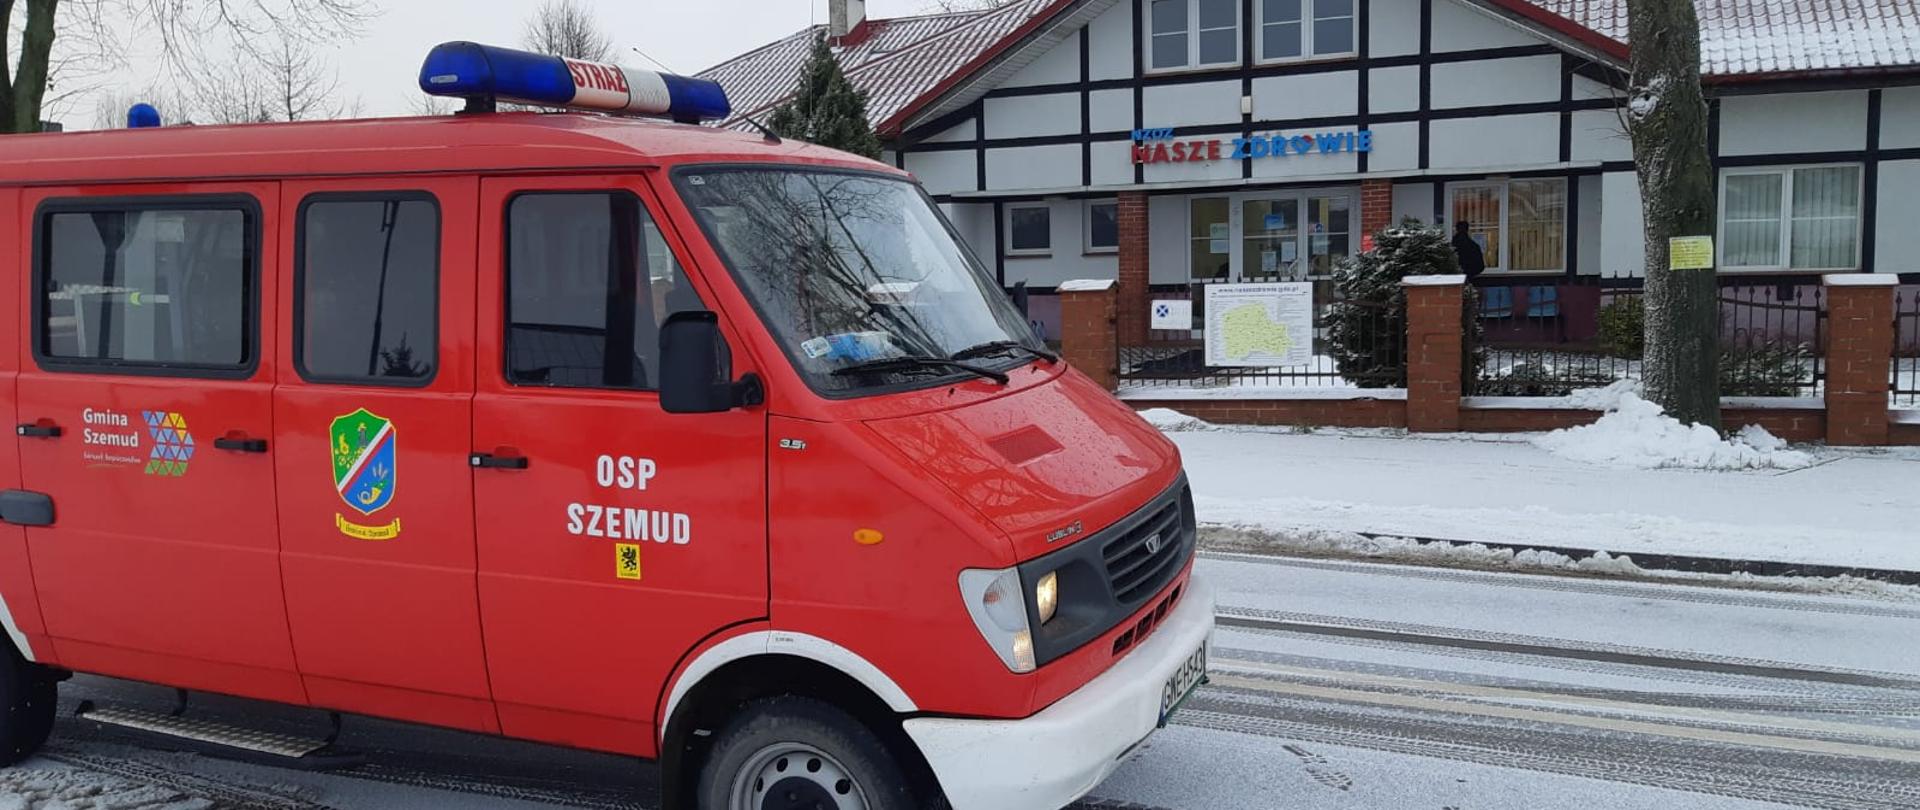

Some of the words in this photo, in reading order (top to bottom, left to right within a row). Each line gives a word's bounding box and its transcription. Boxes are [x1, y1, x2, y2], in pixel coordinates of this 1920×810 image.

[1131, 140, 1221, 165] NASZE
[83, 407, 128, 426] Gmina
[83, 428, 139, 447] Szemud
[596, 454, 657, 490] OSP
[567, 502, 691, 545] SZEMUD
